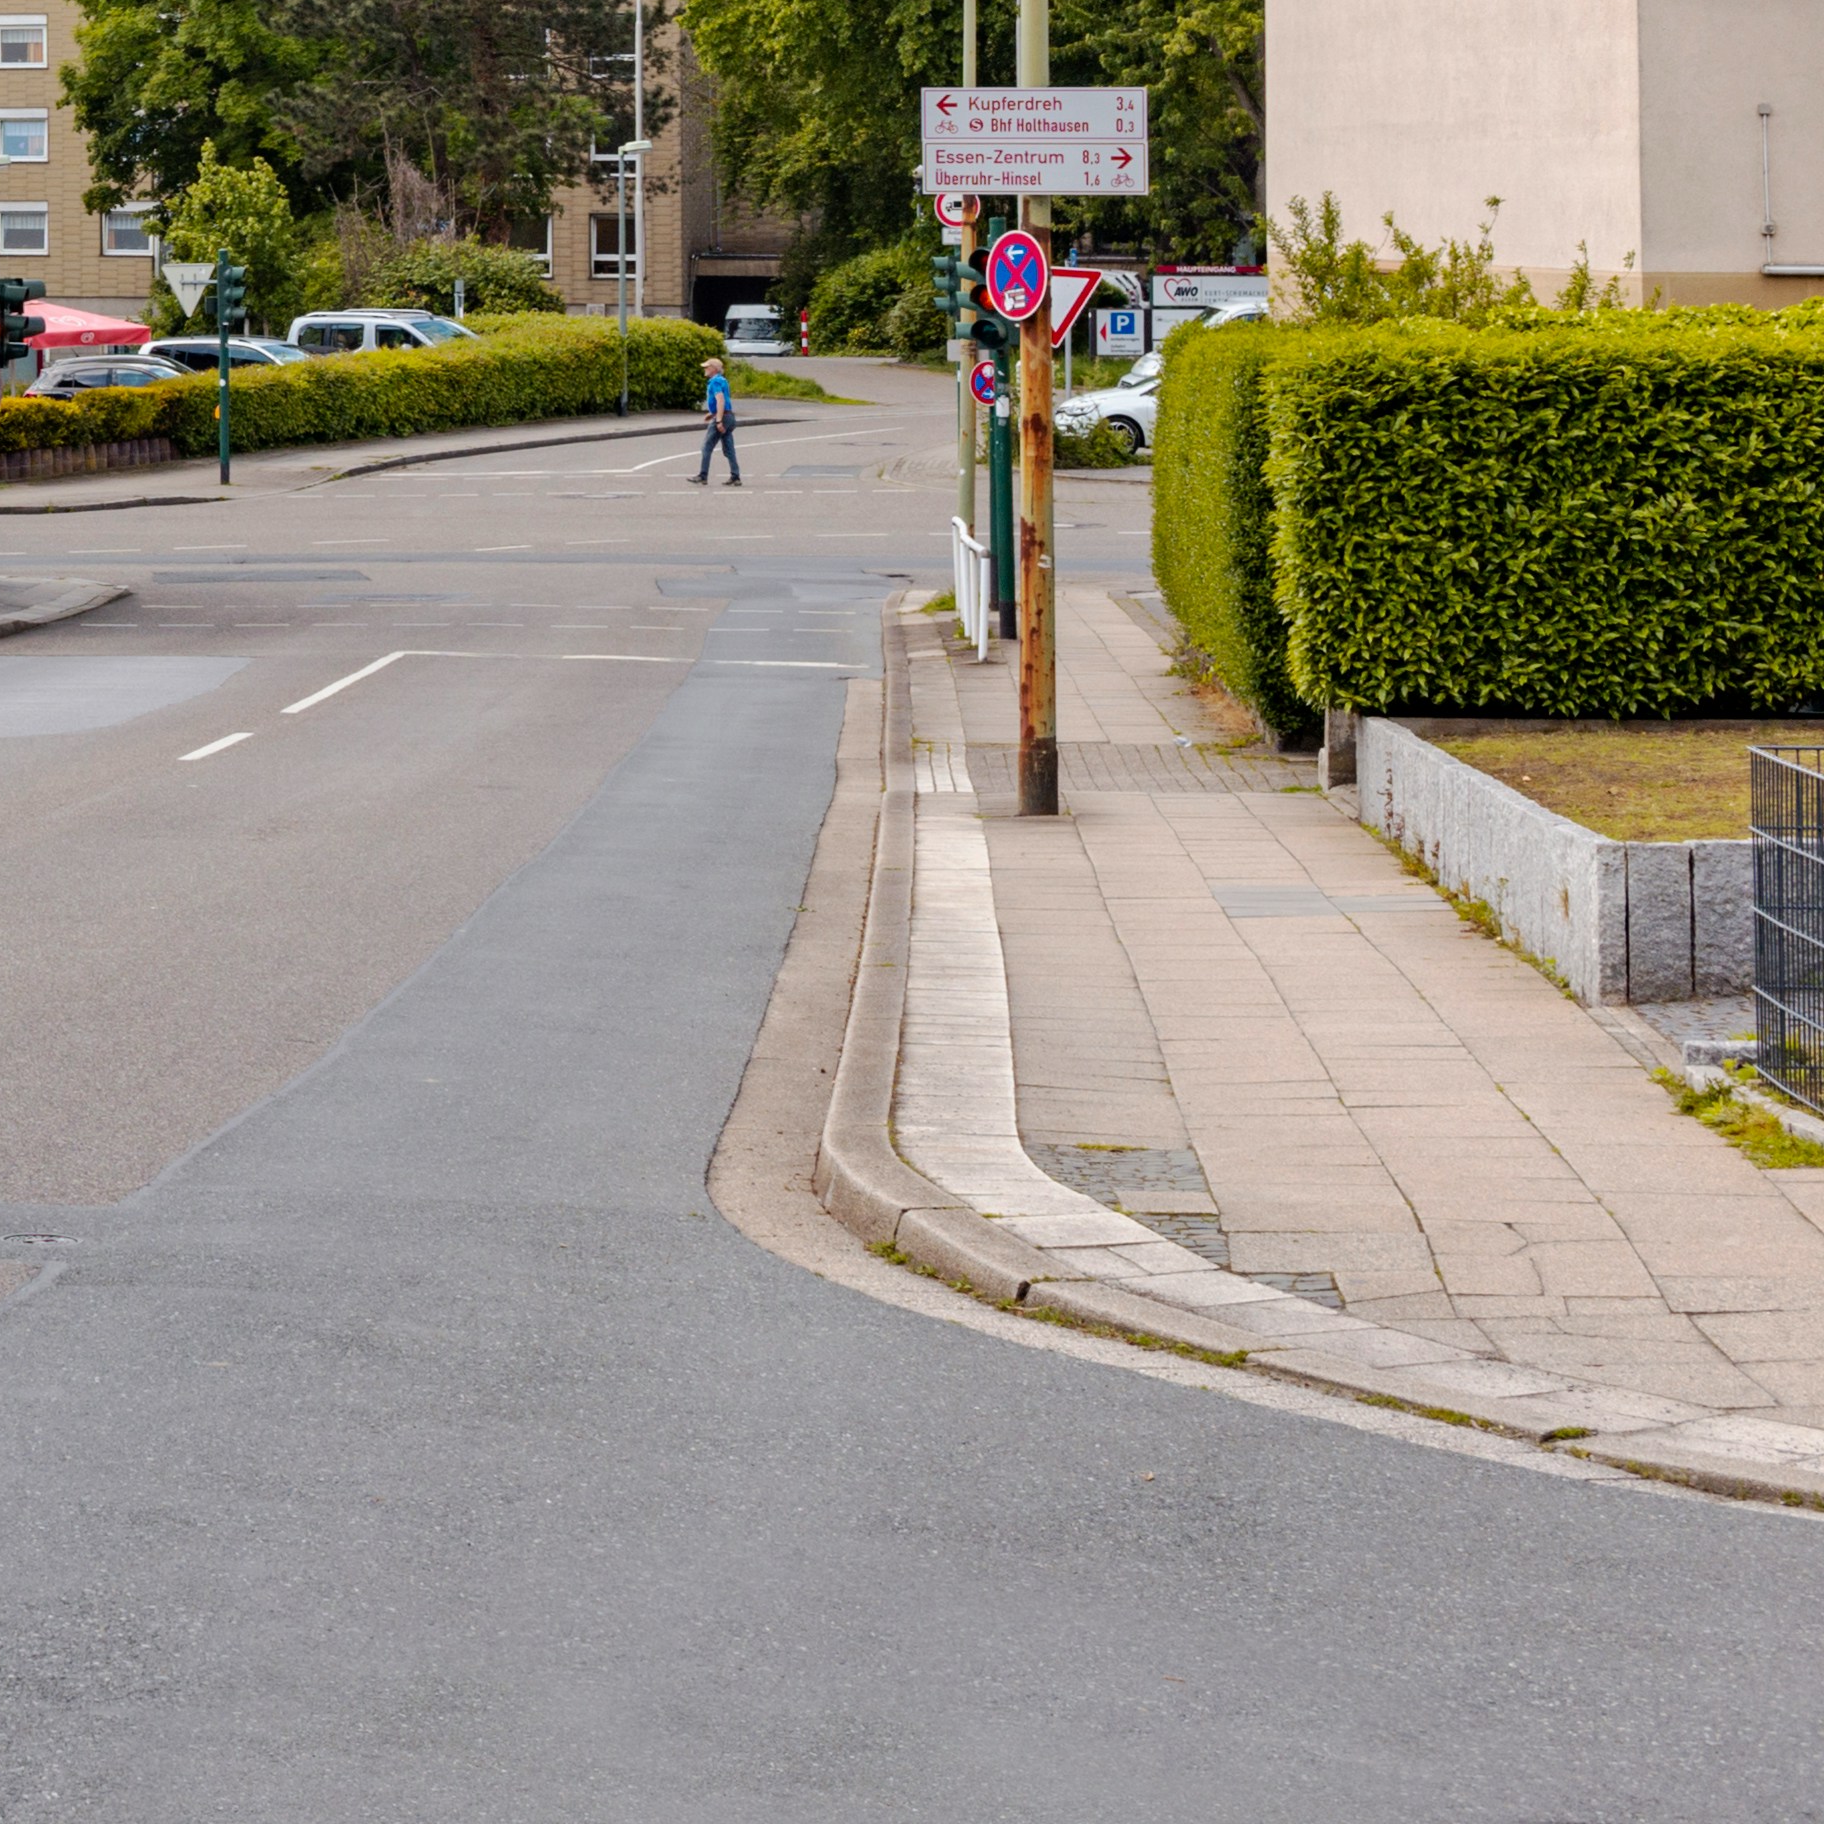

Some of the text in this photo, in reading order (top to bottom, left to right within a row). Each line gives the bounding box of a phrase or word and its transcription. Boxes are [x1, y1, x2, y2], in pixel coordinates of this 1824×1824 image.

[968, 96, 1062, 114] Kupferdreh
[991, 118, 1012, 132] Bhf
[1016, 118, 1089, 132] Holthausen
[935, 150, 1064, 164] Essen-Zentrum
[935, 169, 1042, 186] Überruhr-Hinsel
[1176, 265, 1236, 273] HAUPTEINGANG
[1174, 286, 1199, 297] AWO
[1116, 315, 1130, 332] P
